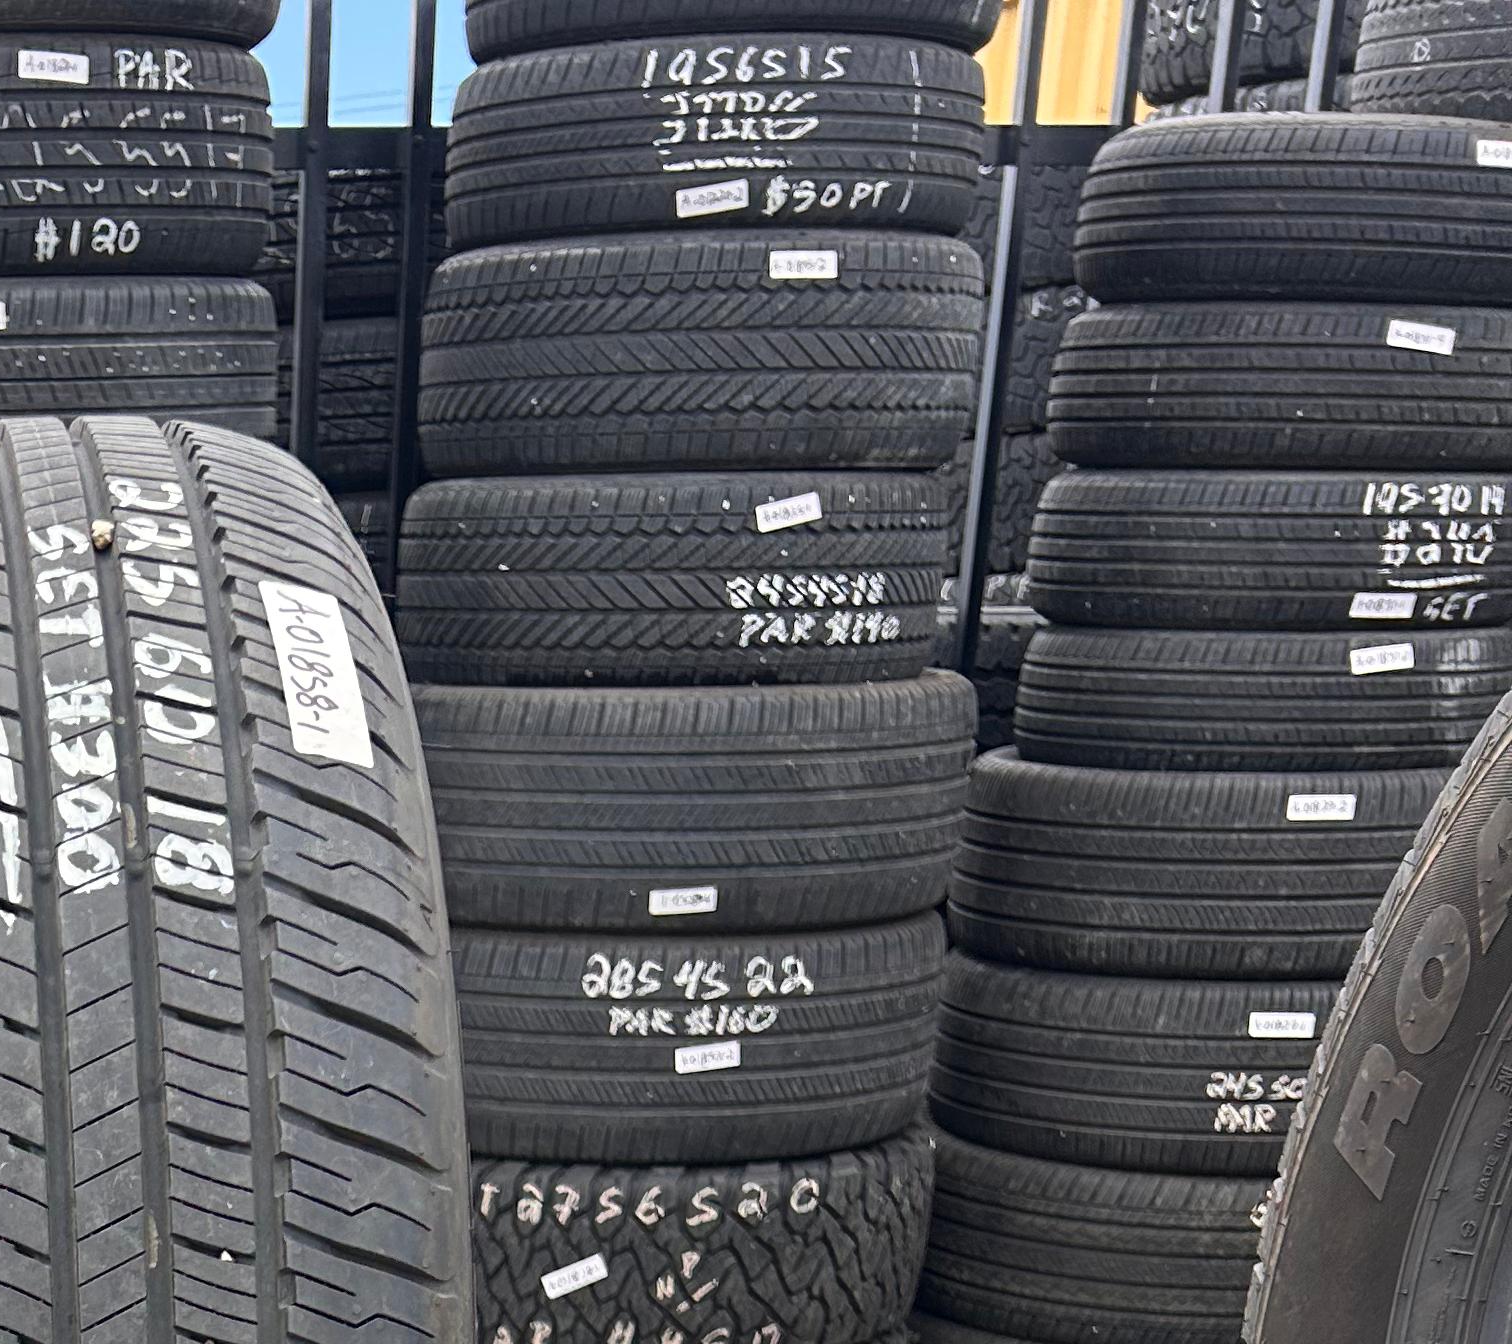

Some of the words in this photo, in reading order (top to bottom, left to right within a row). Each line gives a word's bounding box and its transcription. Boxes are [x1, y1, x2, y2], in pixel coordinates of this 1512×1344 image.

[115, 49, 194, 90] PAR
[27, 523, 105, 649] SET
[133, 632, 217, 745] 60
[277, 589, 340, 734] A-01858-1
[146, 794, 235, 896] 18
[581, 952, 665, 1000] 285
[673, 959, 731, 1000] 45
[743, 955, 815, 998] 22
